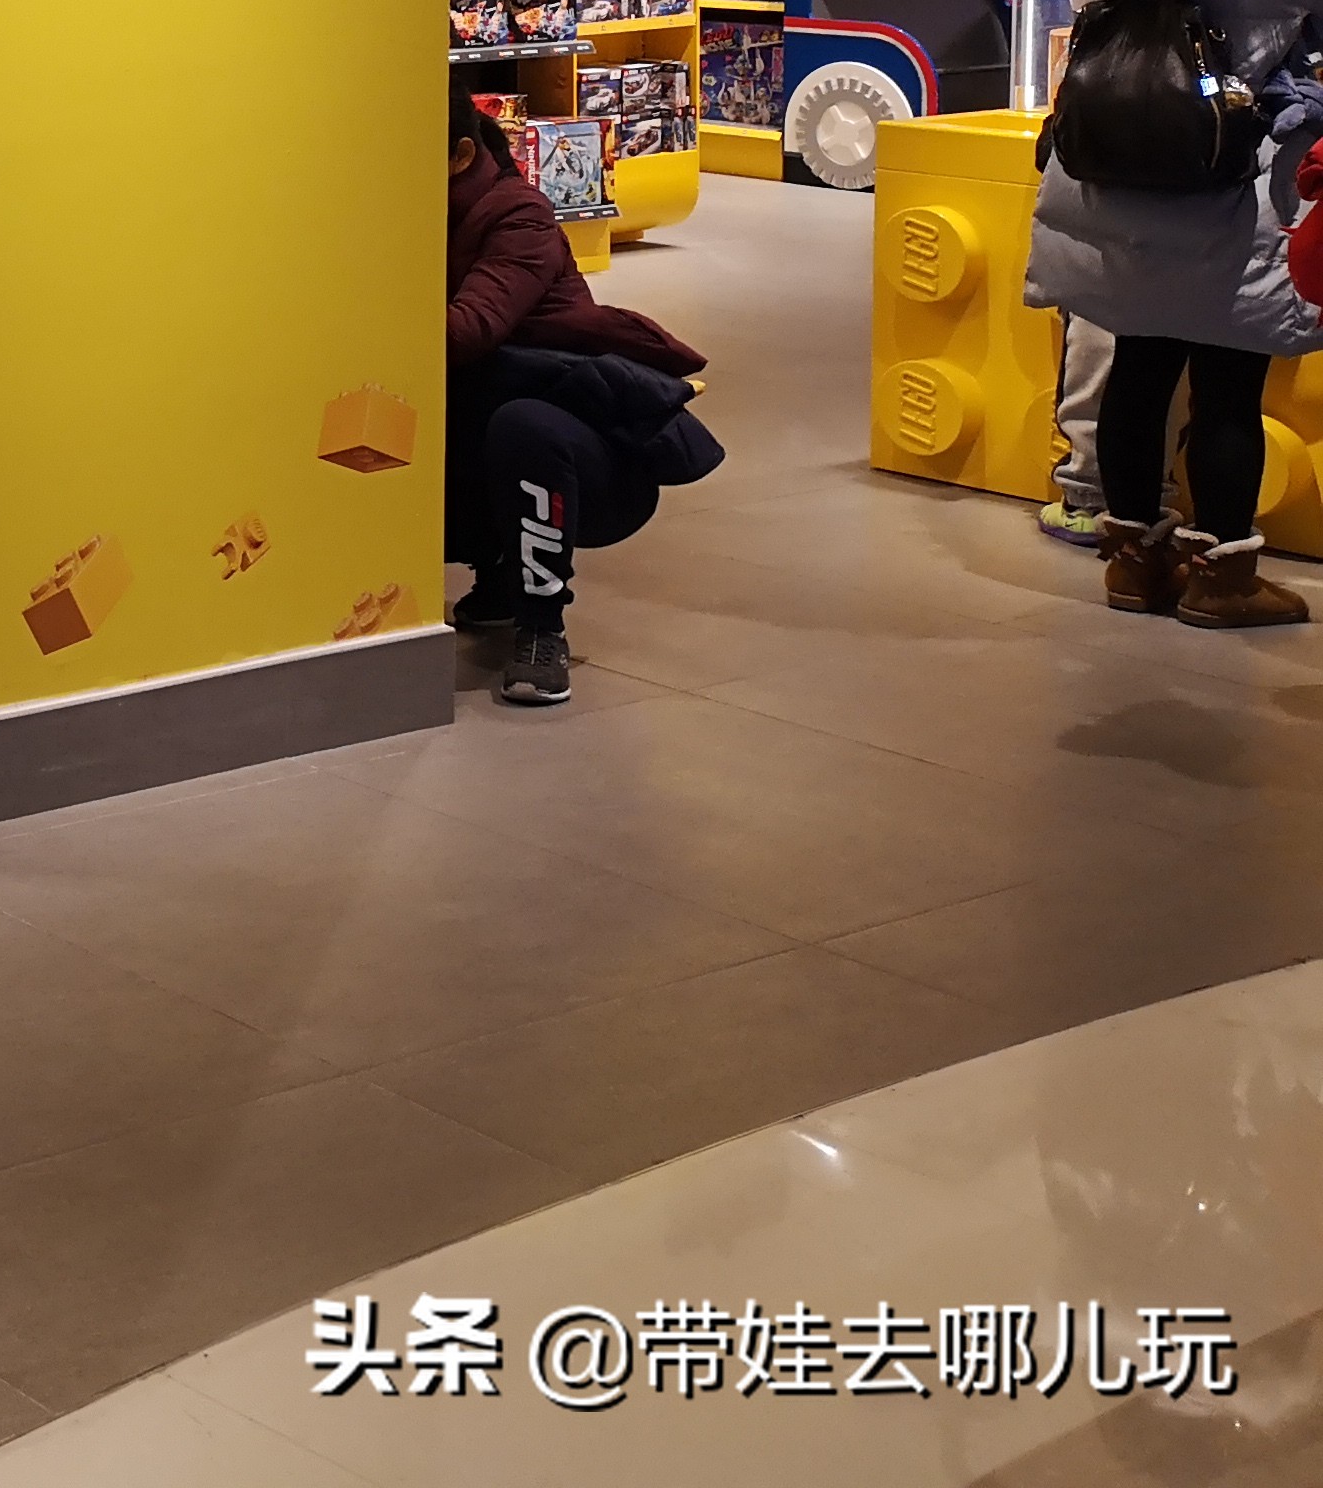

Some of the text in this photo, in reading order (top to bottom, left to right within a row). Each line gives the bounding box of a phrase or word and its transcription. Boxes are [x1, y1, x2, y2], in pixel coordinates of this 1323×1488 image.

[902, 217, 940, 296] LEGO
[900, 371, 937, 450] LEGO
[520, 480, 564, 596] FILA
